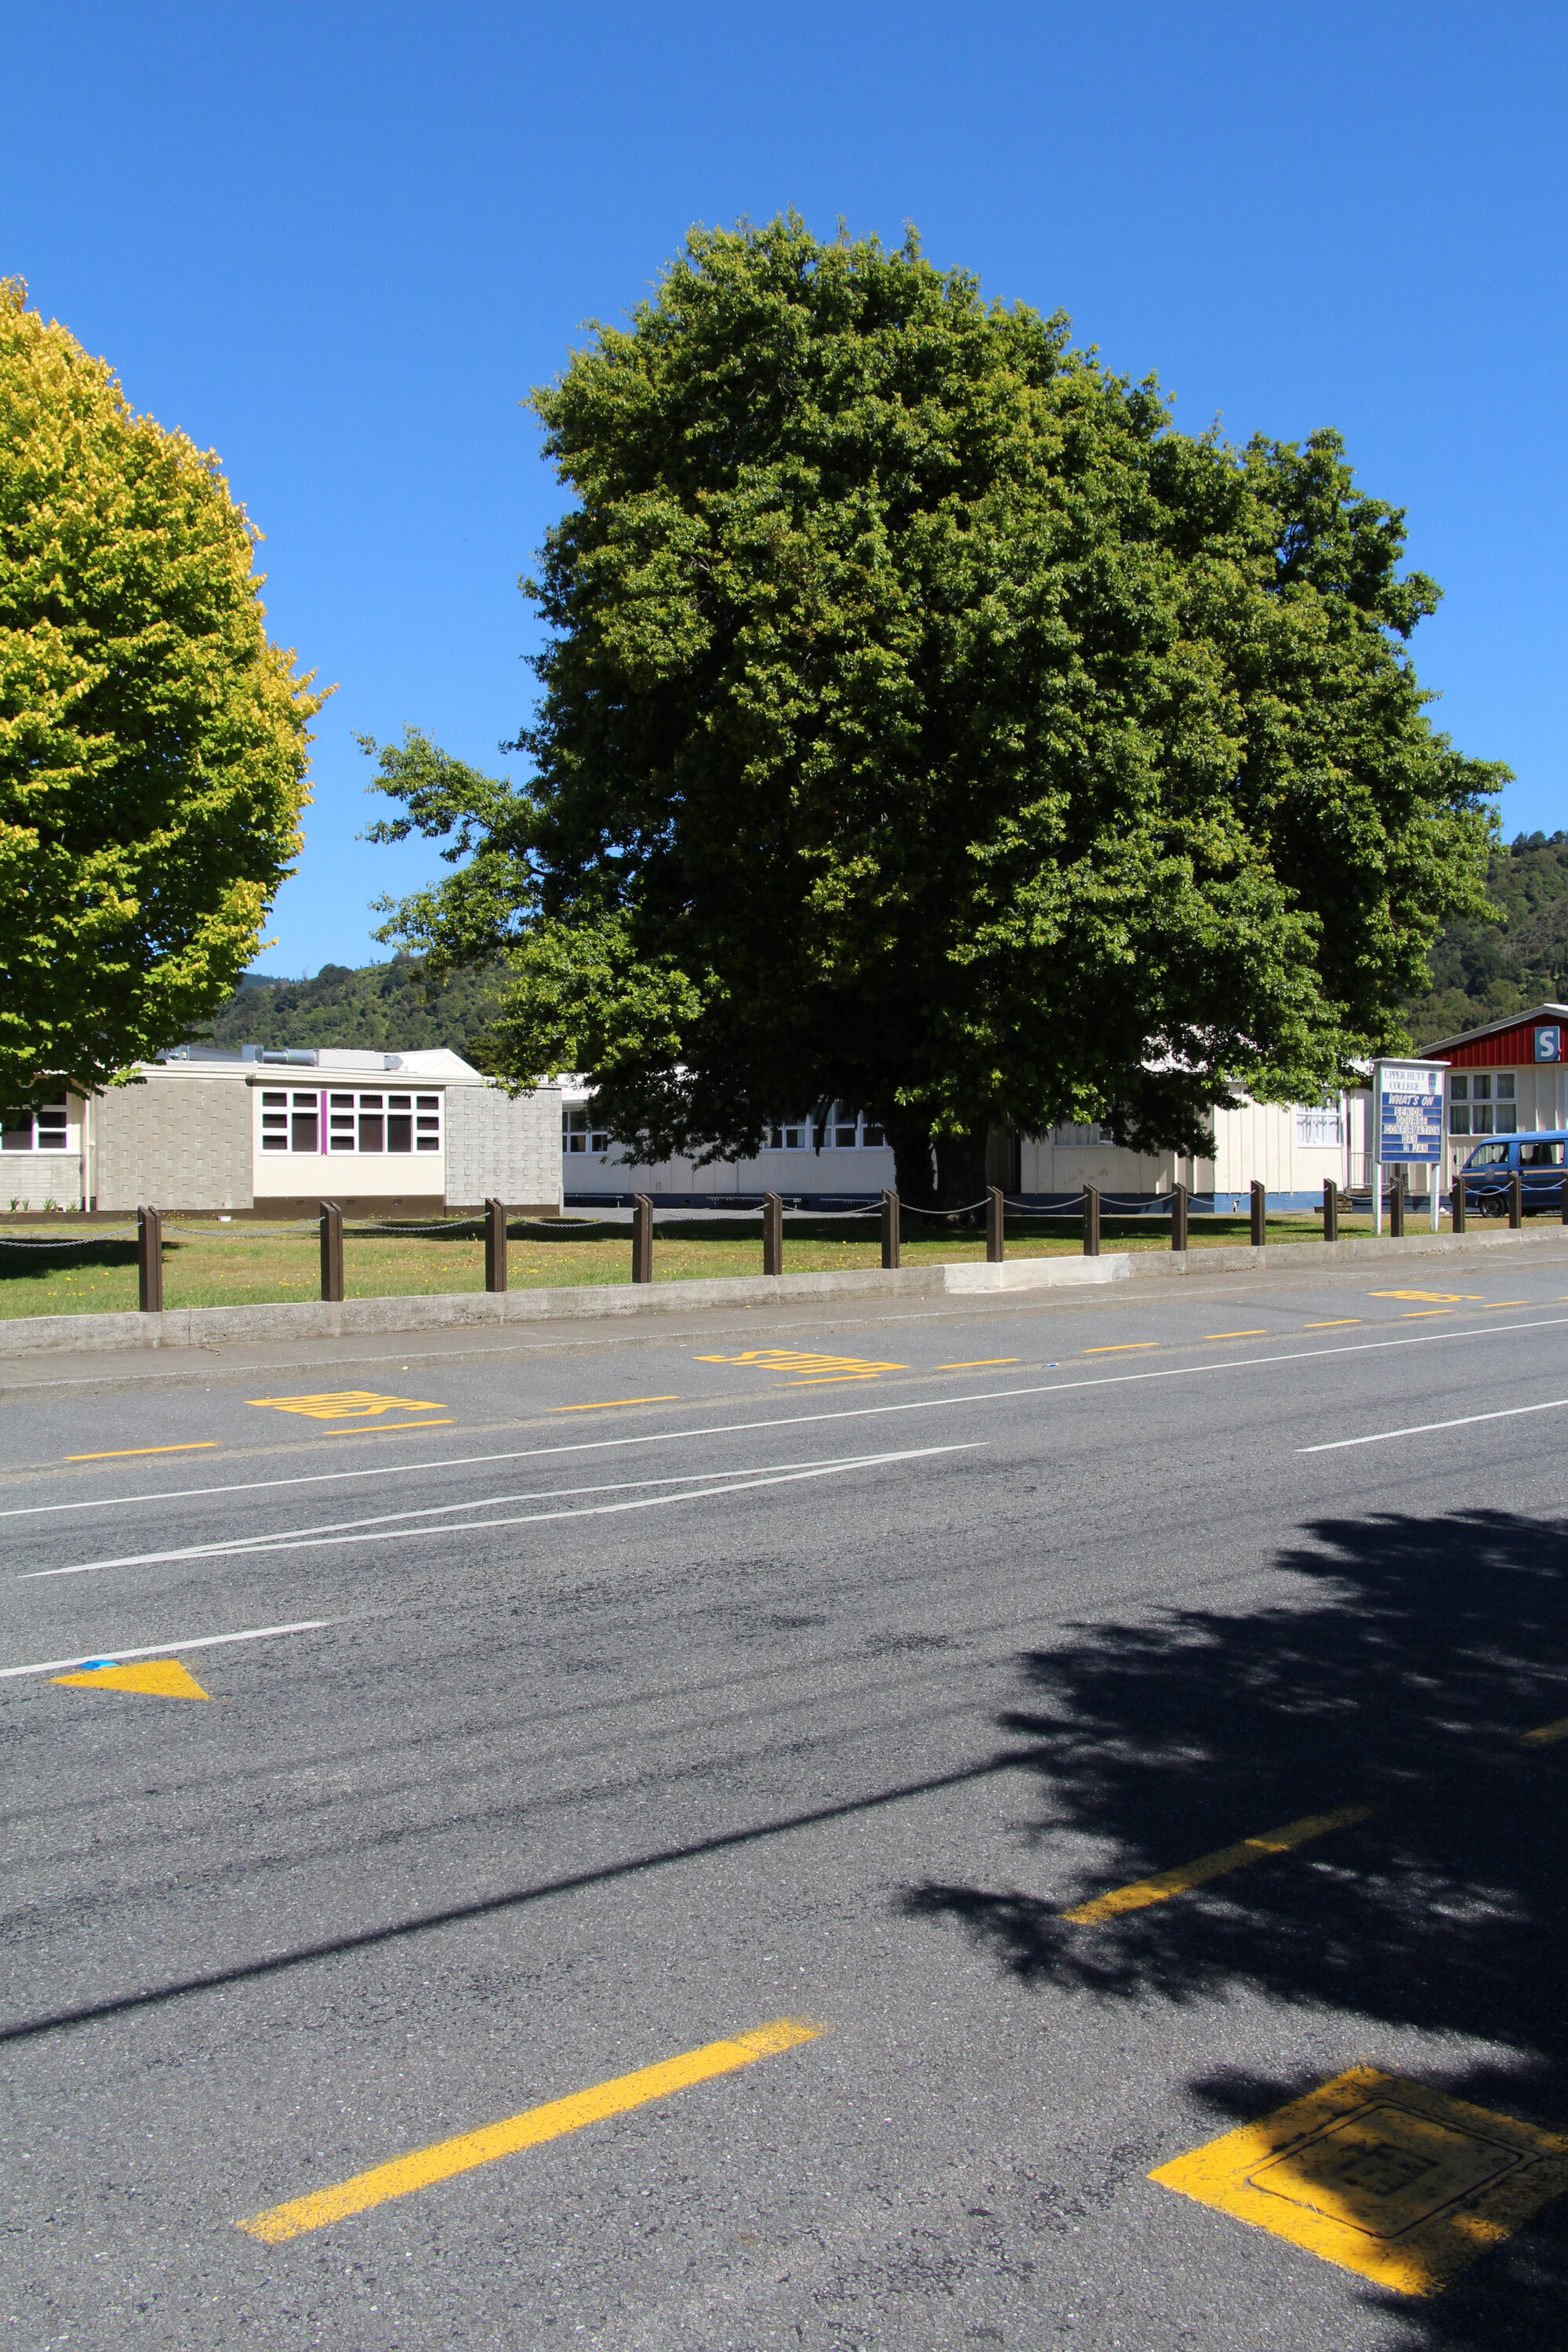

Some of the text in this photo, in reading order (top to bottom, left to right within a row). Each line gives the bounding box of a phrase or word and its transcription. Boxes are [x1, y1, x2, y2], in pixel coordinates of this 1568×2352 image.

[1540, 1031, 1554, 1057] S
[1385, 1070, 1425, 1080] UPPER HUTT
[1389, 1081, 1420, 1091] COLLEGE
[1388, 1094, 1435, 1106] WHAT'S ON
[1396, 1107, 1423, 1116] SENIOR
[1397, 1116, 1428, 1125] COURSE
[1385, 1125, 1440, 1134] CONFIRMATION
[1403, 1134, 1417, 1143] DAY
[1414, 1144, 1428, 1152] JAN
